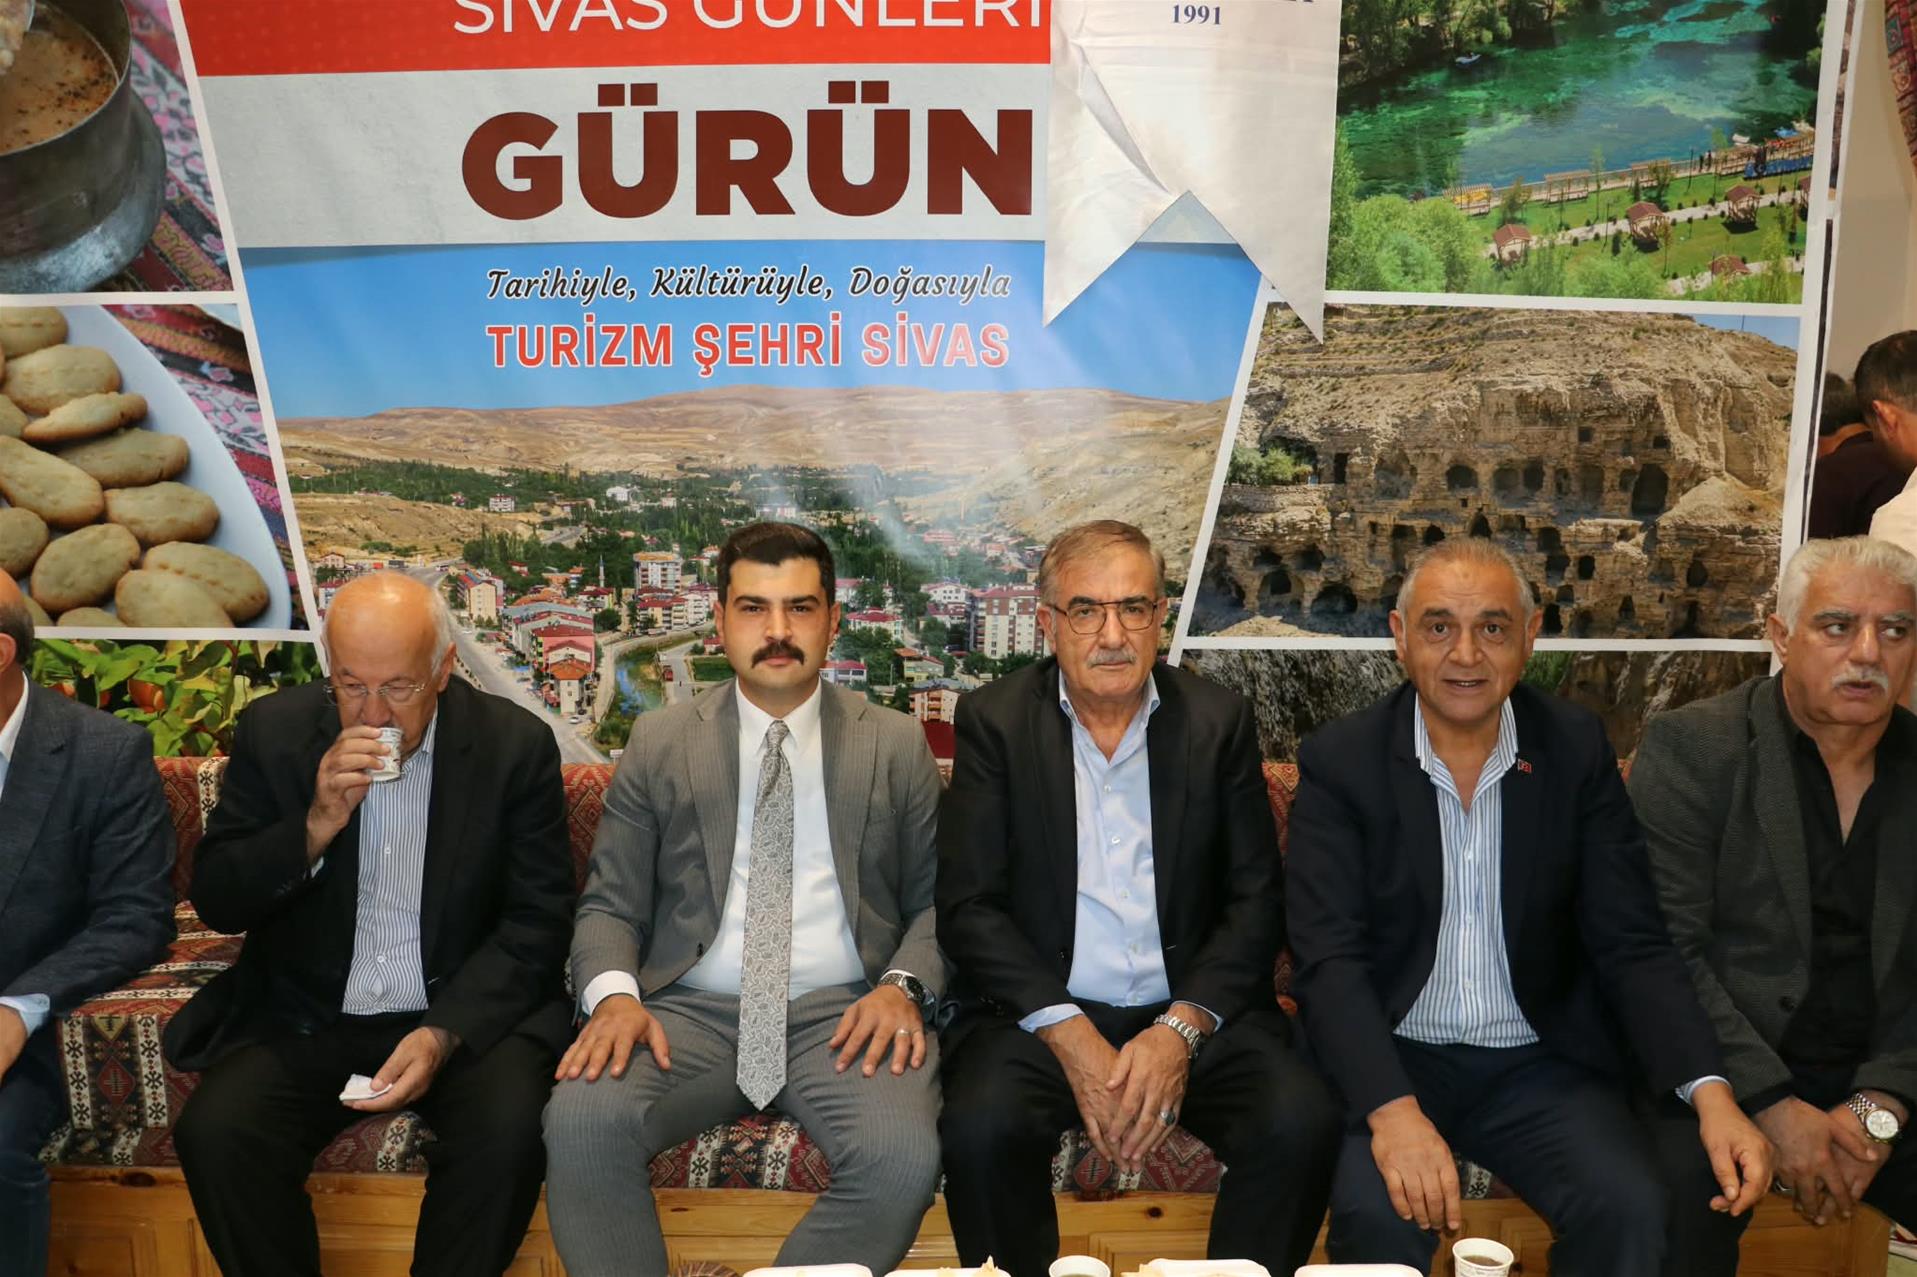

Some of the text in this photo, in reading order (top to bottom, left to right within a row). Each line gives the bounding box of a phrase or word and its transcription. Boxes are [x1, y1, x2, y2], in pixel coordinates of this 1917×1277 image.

[1172, 4, 1222, 25] 1991
[461, 80, 1034, 221] GÜRÜN
[487, 263, 1012, 307] Tarihiyle, Kültürüyle, Doğasıyla
[486, 310, 1010, 378] TURİZM ŞEHRİ SİVAS
